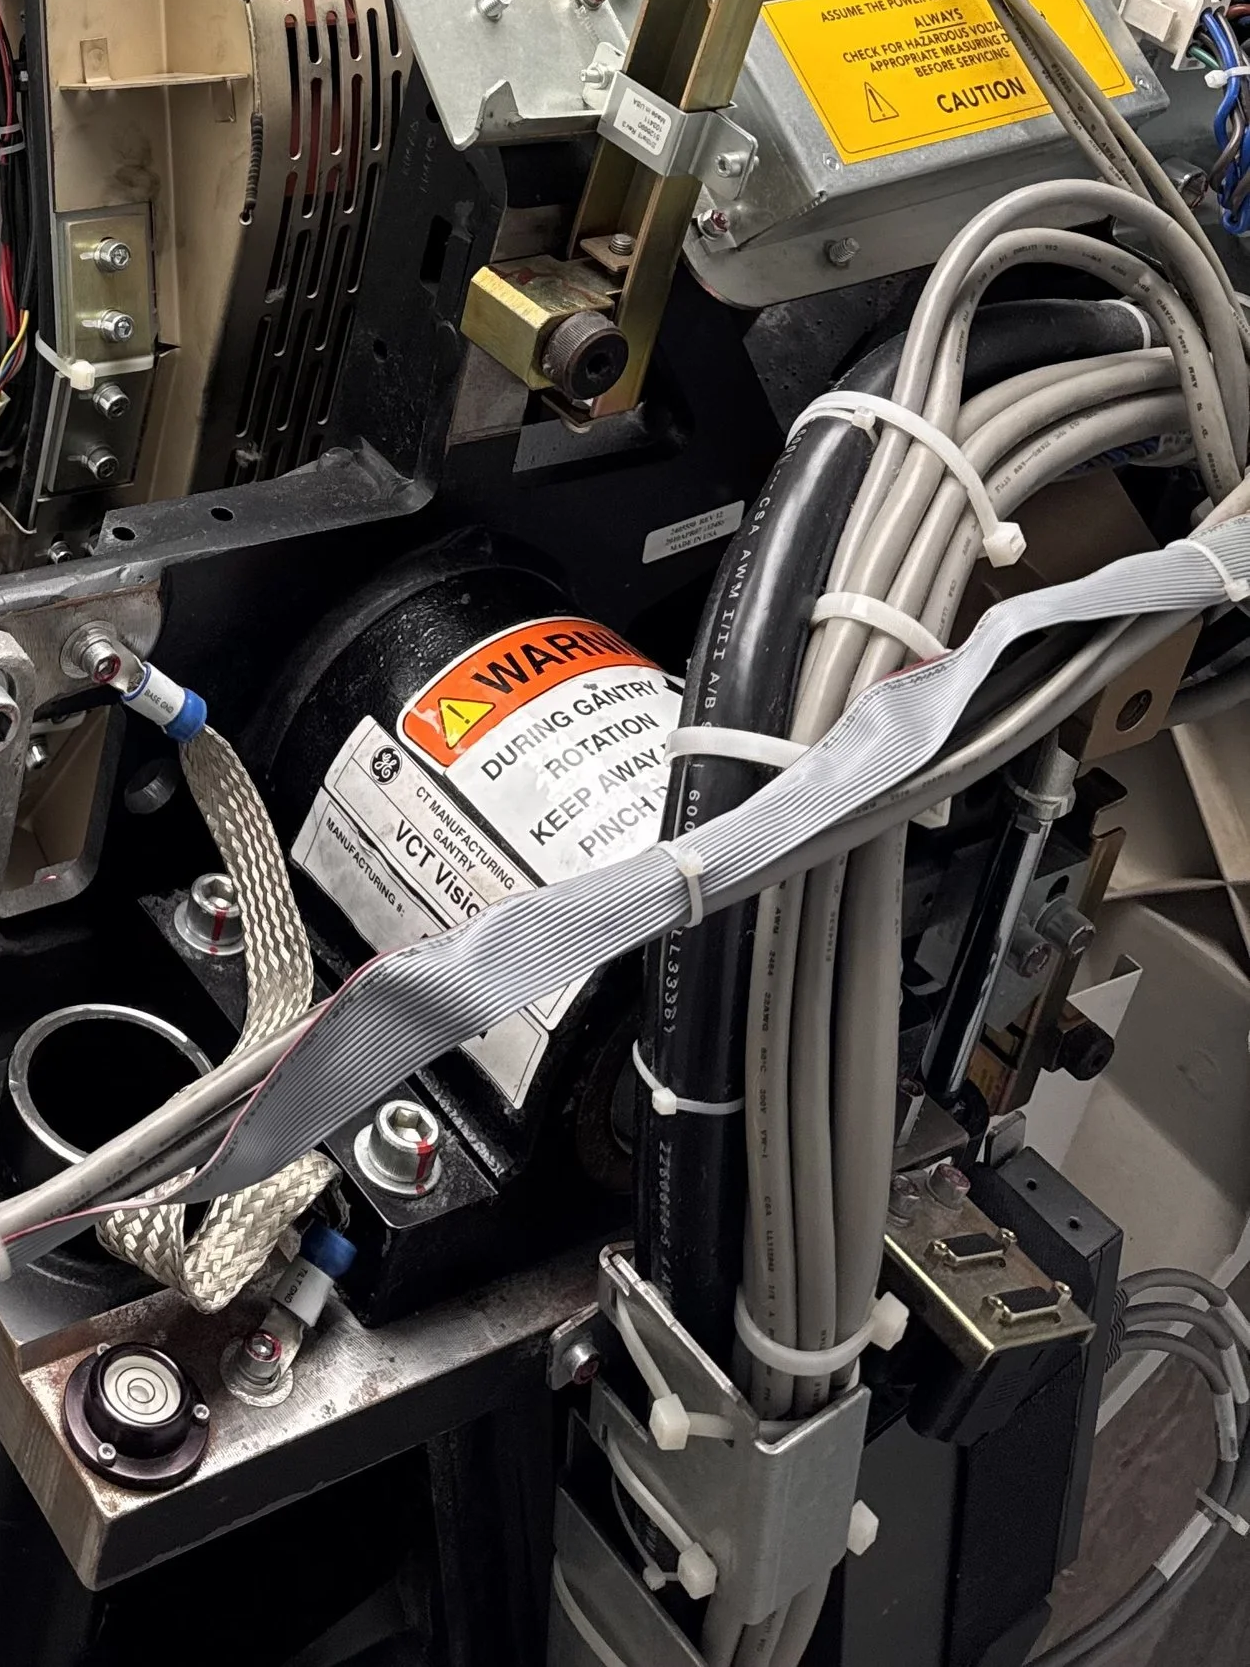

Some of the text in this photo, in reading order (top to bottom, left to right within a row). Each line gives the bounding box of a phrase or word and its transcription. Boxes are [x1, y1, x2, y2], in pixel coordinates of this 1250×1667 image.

[820, 4, 865, 23] ASSUME
[913, 7, 964, 30] ALWAYS
[842, 19, 1003, 64] CHECK FOR HAZARDOUS VOLTA
[869, 49, 939, 74] APPROPRIATE
[942, 36, 1001, 59] MEASURING
[913, 47, 1011, 78] BEFORE SERVICING
[935, 75, 1028, 115] CAUTION
[748, 495, 772, 536] CSA
[727, 548, 752, 599] AWM
[471, 629, 632, 695] WARNI
[144, 688, 175, 715] BASE GND
[703, 671, 721, 710] A/B
[480, 679, 660, 782] DURING GANTRY
[544, 711, 660, 781] ROTATION
[528, 747, 662, 847] KEEP AWAY
[415, 785, 516, 892] CT MANUFACTURING
[577, 795, 658, 859] PINCH
[324, 816, 397, 905] MANUFACTURING
[394, 819, 482, 921] VCT Visio
[432, 827, 477, 874] GANTRY
[284, 1285, 298, 1304] GND
